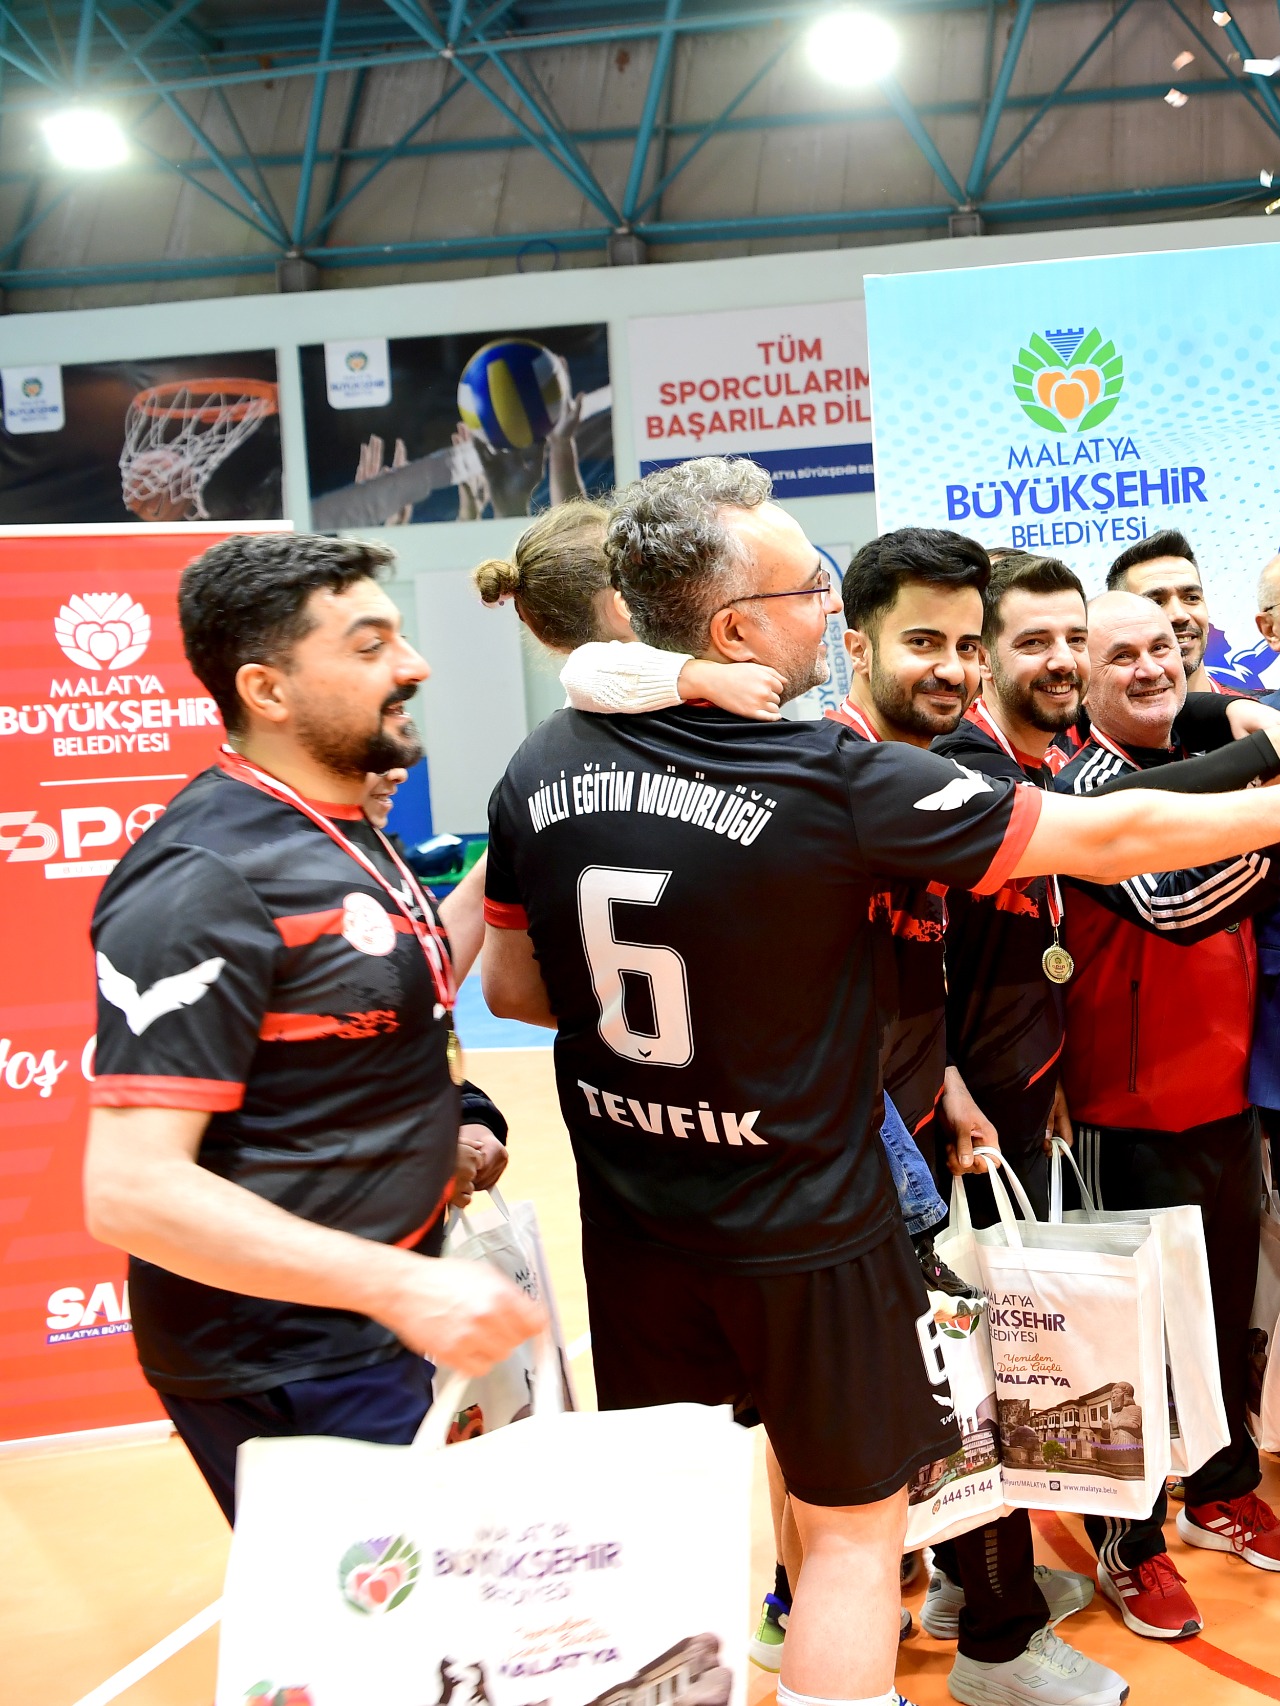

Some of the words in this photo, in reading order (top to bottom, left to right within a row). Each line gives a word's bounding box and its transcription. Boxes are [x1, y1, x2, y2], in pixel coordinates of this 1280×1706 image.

[758, 335, 823, 365] TÜM
[646, 403, 817, 442] BAŞARILAR
[825, 393, 872, 425] DİL
[1007, 436, 1141, 470] MALATYA
[50, 675, 165, 698] MALATYA
[527, 769, 570, 834] MİLLİ
[572, 761, 635, 816] EĞİTİM
[637, 764, 778, 847] MÜDÜRLÜĞÜ
[576, 864, 694, 1068] 6
[577, 1079, 769, 1146] TEVFİK
[49, 1327, 100, 1343] MALATYA
[996, 1361, 1027, 1372] Daha
[1030, 1361, 1063, 1373] Güçlü
[1003, 1353, 1053, 1363] Yeniden
[942, 1489, 962, 1505] 444
[964, 1484, 975, 1497] 51
[978, 1479, 993, 1492] 44
